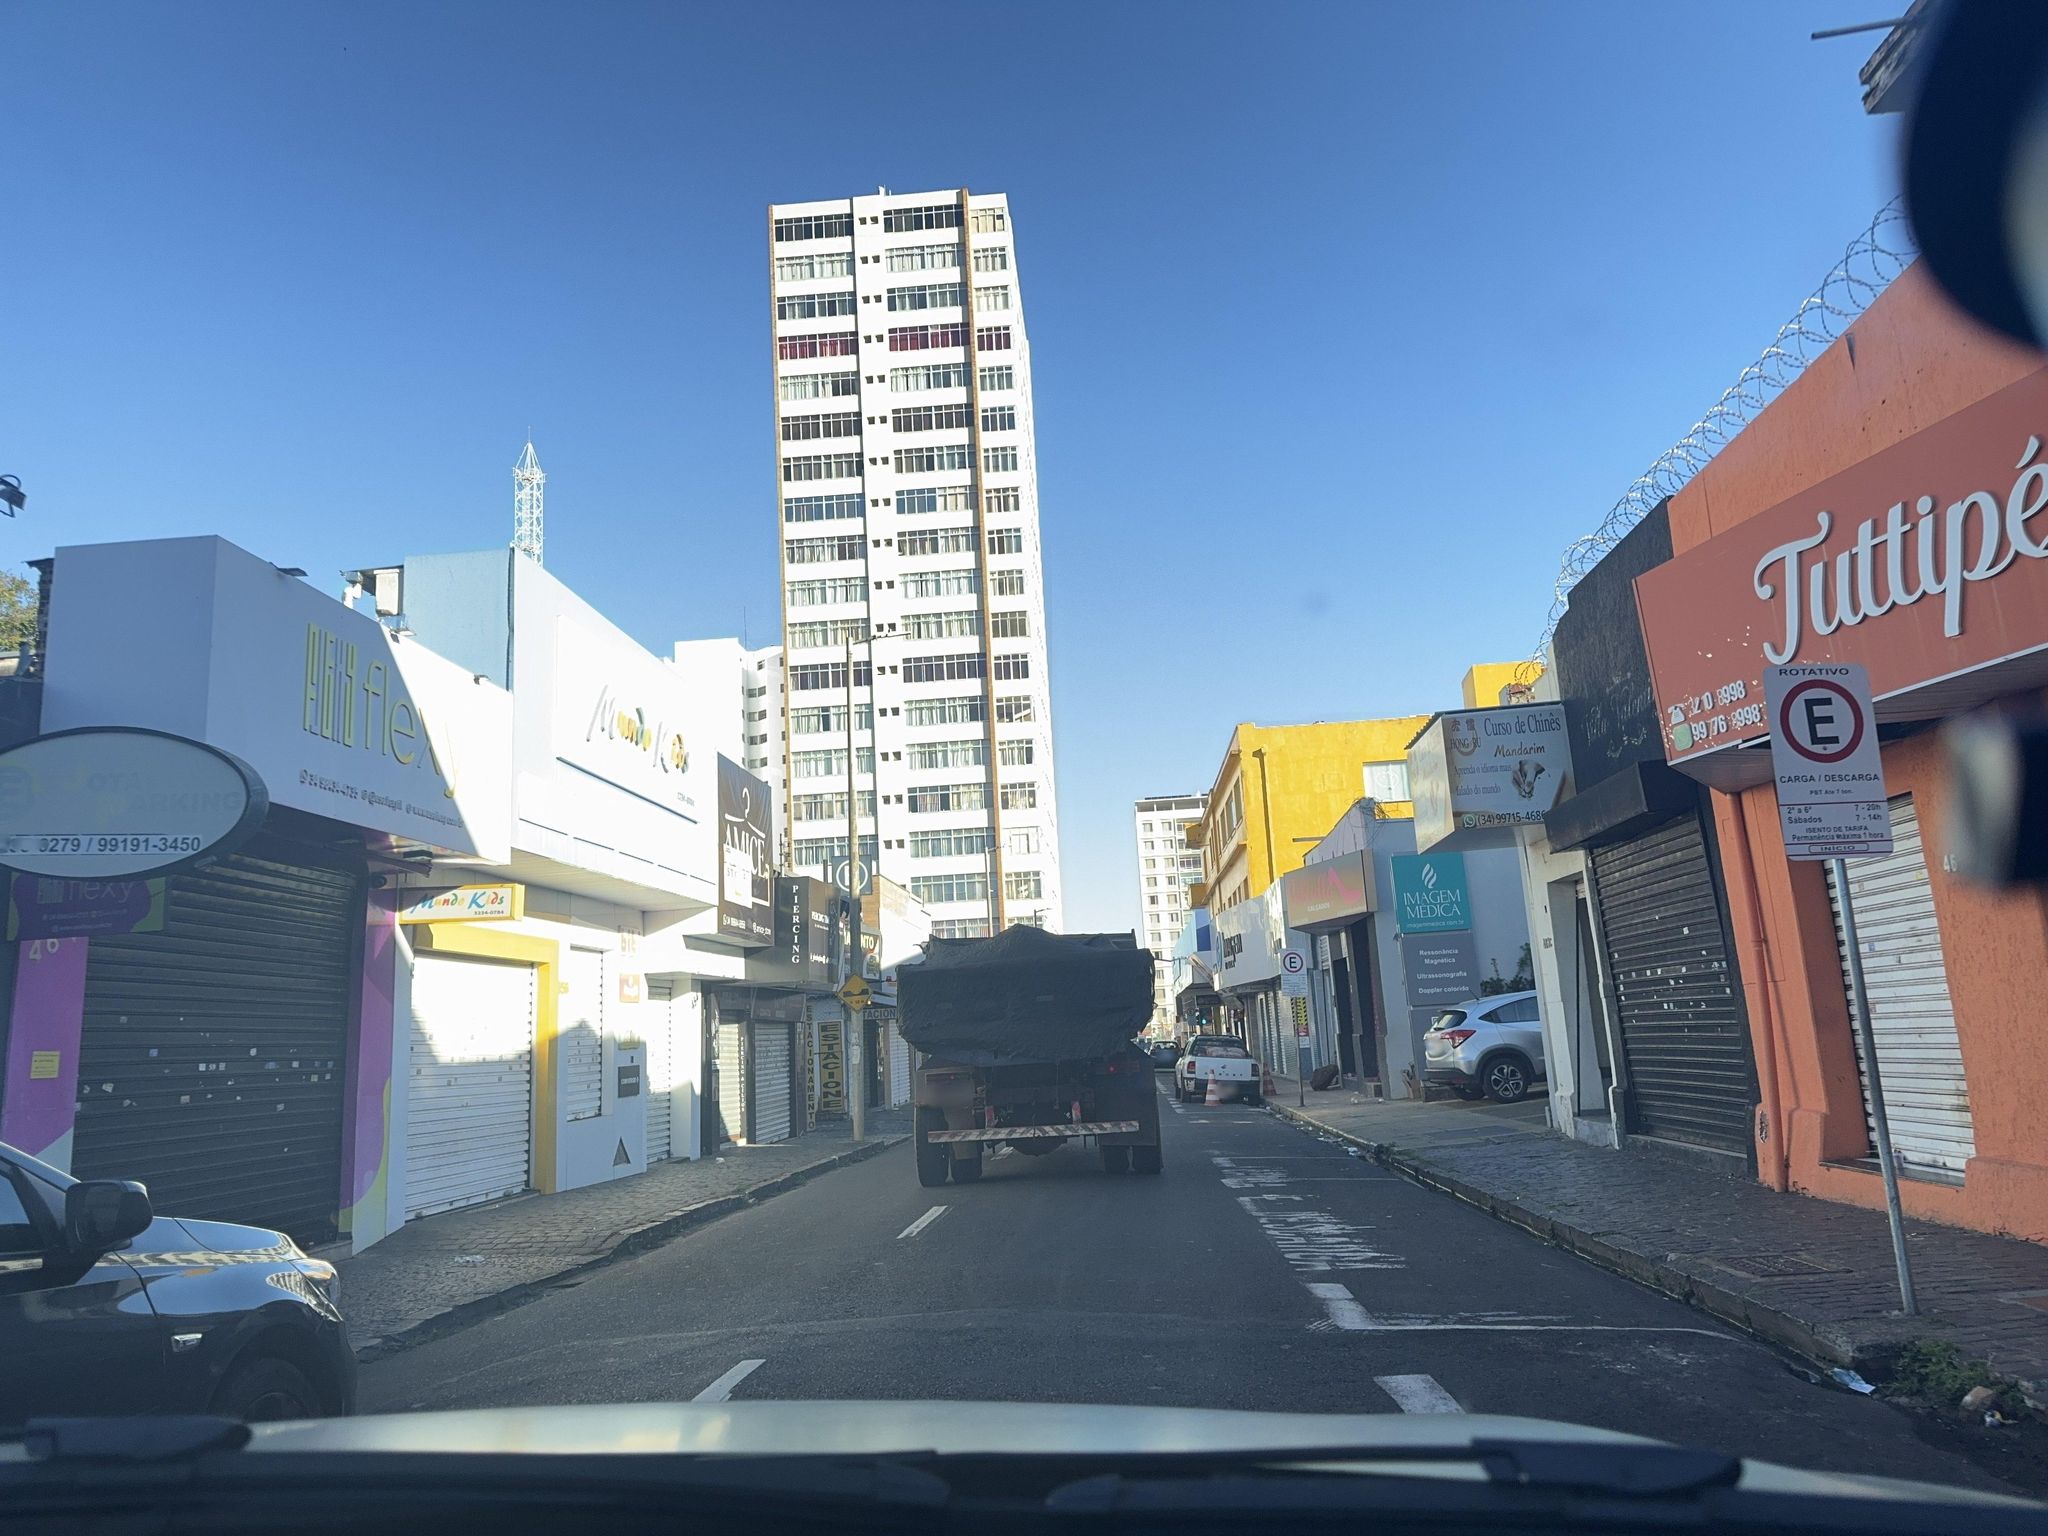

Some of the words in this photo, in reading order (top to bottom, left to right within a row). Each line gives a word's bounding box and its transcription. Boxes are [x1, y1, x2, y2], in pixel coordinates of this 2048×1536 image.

[1779, 667, 1849, 677] ROTATIVO
[1484, 718, 1512, 737] Curso
[1515, 715, 1526, 734] de
[1527, 712, 1561, 733] Chinês
[1804, 697, 1840, 745] E
[1494, 741, 1545, 758] Mandarim
[1779, 775, 1816, 784] CARGA
[1818, 774, 1822, 782] /
[1824, 773, 1880, 783] DESCARGA
[1477, 814, 1495, 826] (34)
[1806, 826, 1831, 834] ISENTO
[97, 837, 201, 852] 99191-3450
[409, 893, 465, 914] Mundo
[467, 891, 505, 910] Kids
[1403, 889, 1461, 905] IMAGEM
[792, 885, 800, 964] PIERCING
[1419, 948, 1459, 956] Ressonância
[1289, 956, 1297, 969] E
[1424, 957, 1456, 965] Magnética
[1416, 971, 1467, 980] Ultrassonografia
[1418, 987, 1443, 995] Doppler
[1444, 985, 1469, 993] colorido
[806, 1005, 815, 1130] ESTACIONAMENTO
[820, 1022, 843, 1109] ESTACIONE
